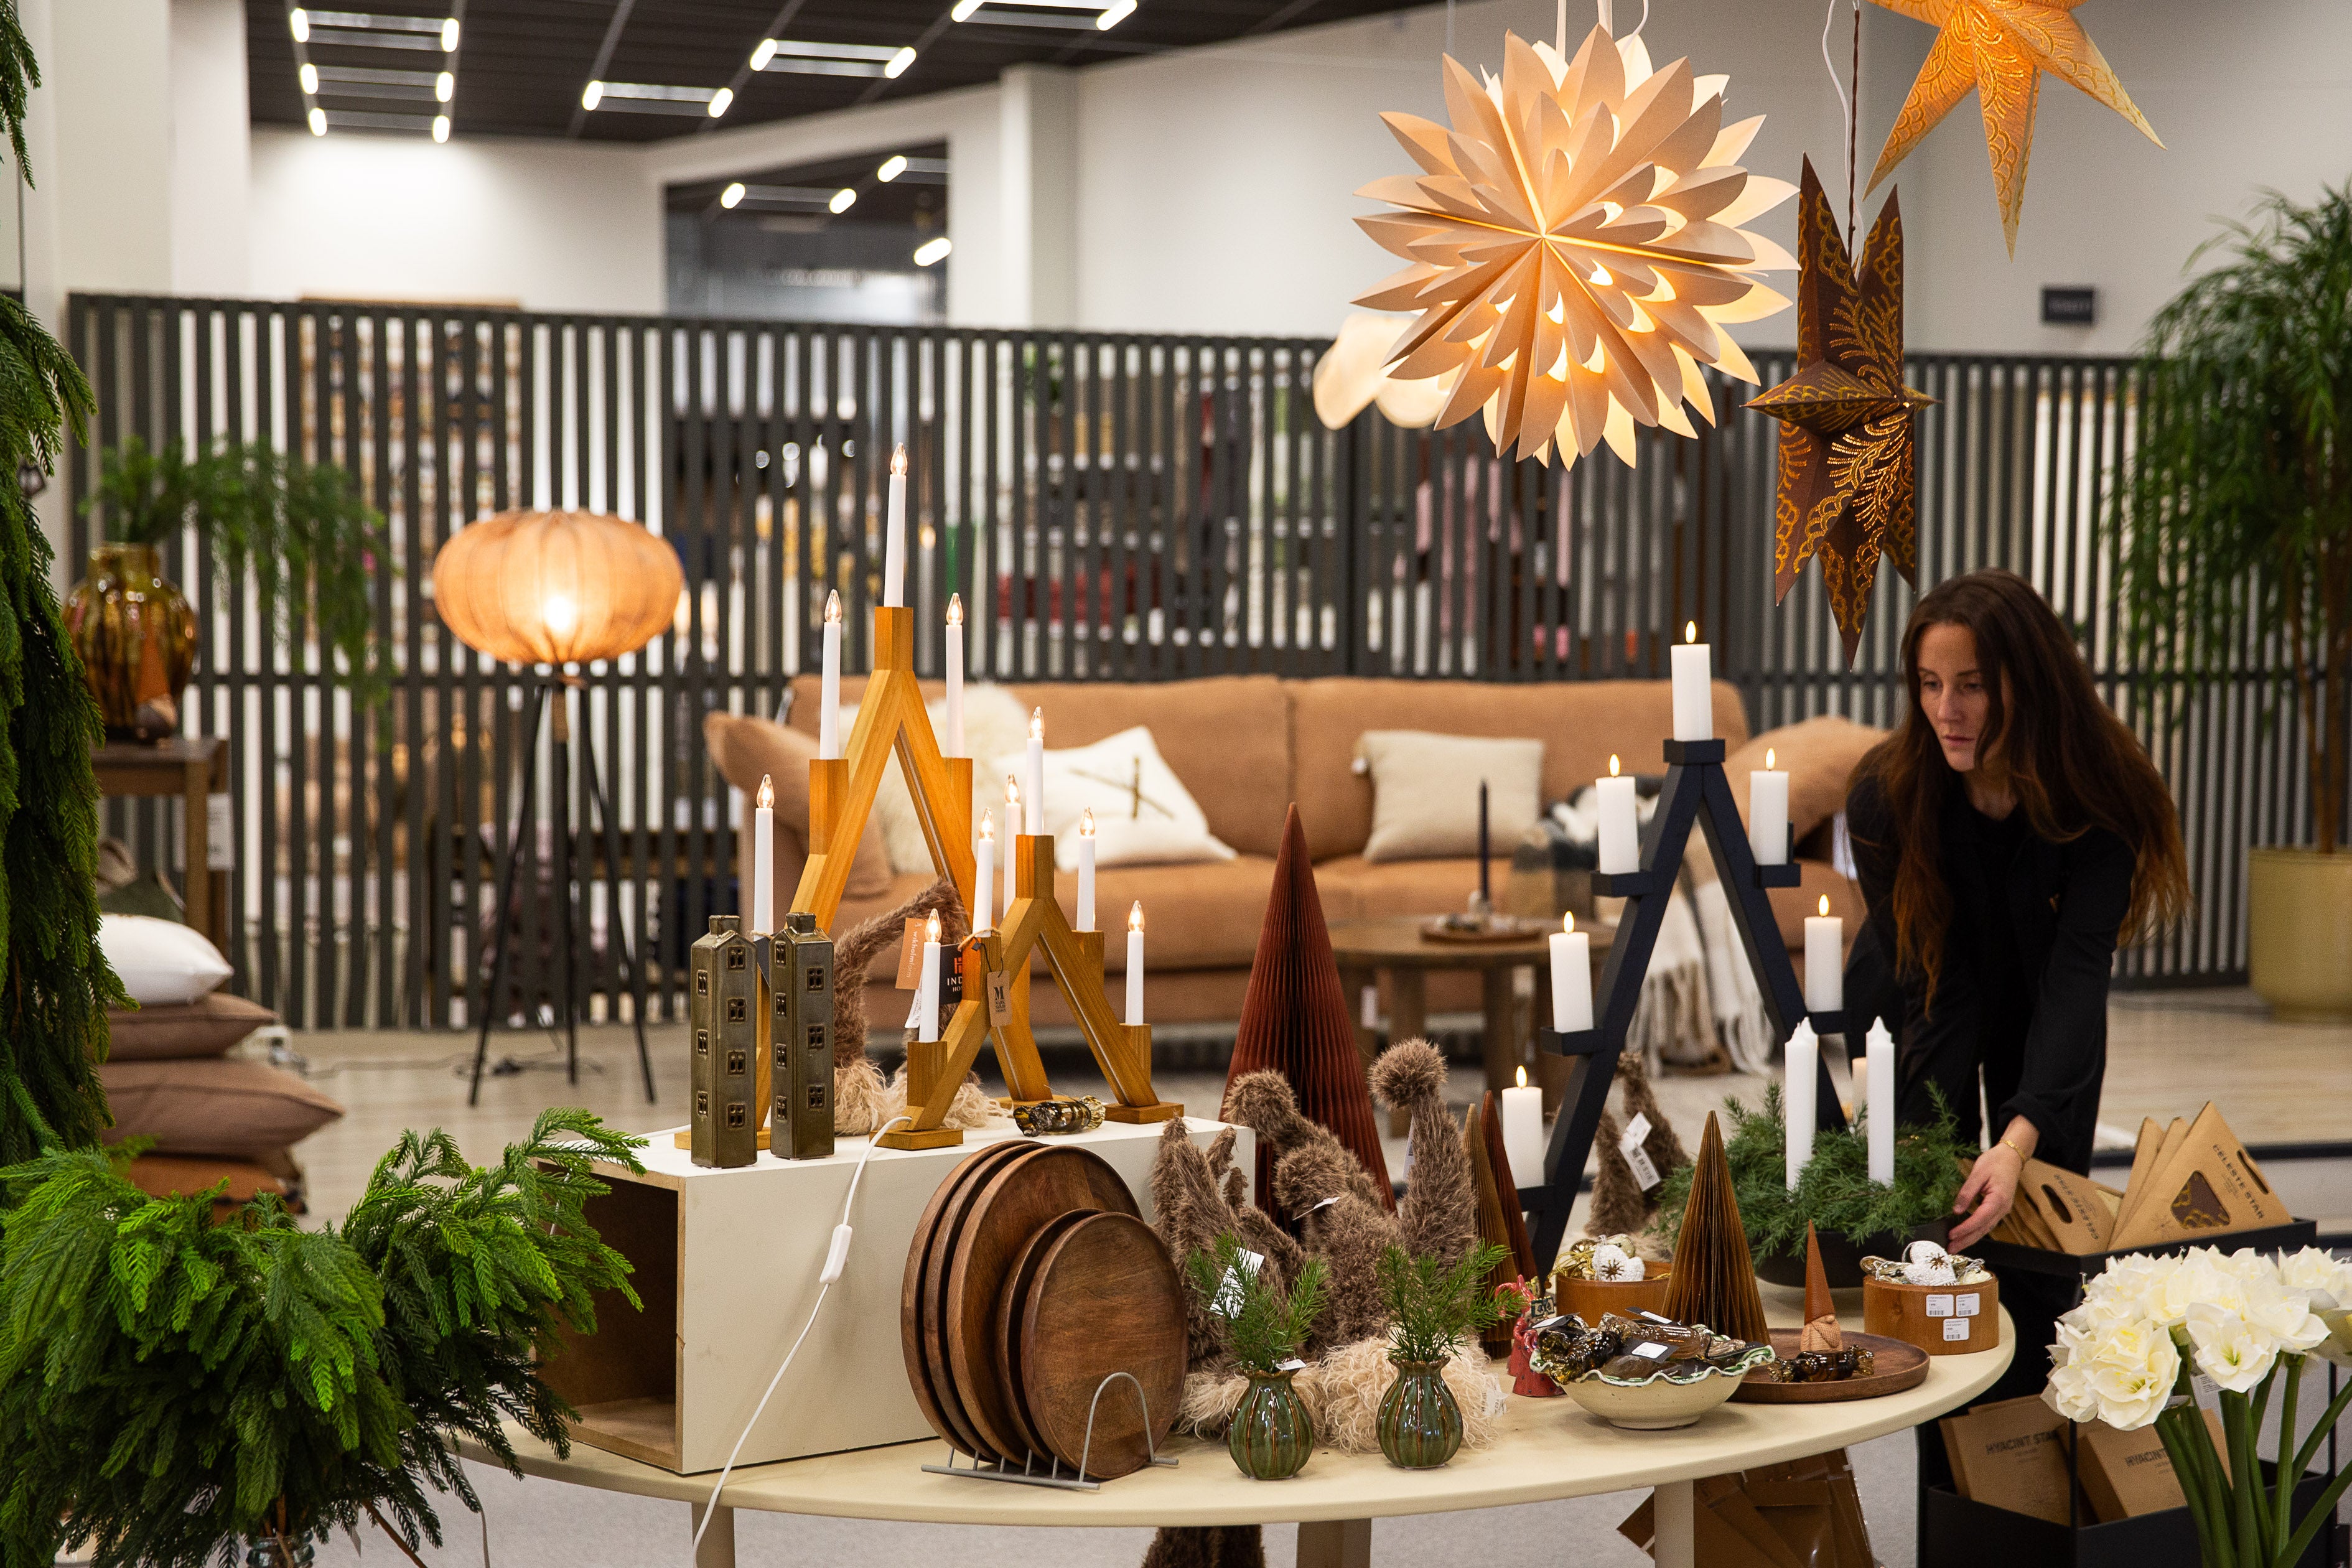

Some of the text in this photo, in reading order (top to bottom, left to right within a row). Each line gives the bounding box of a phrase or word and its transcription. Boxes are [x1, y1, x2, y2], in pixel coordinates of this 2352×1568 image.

[947, 976, 962, 986] IND
[994, 986, 1004, 1000] M
[2213, 1144, 2246, 1190] CELESTE
[2245, 1191, 2264, 1219] STAR
[1986, 1435, 2030, 1455] HYACINT
